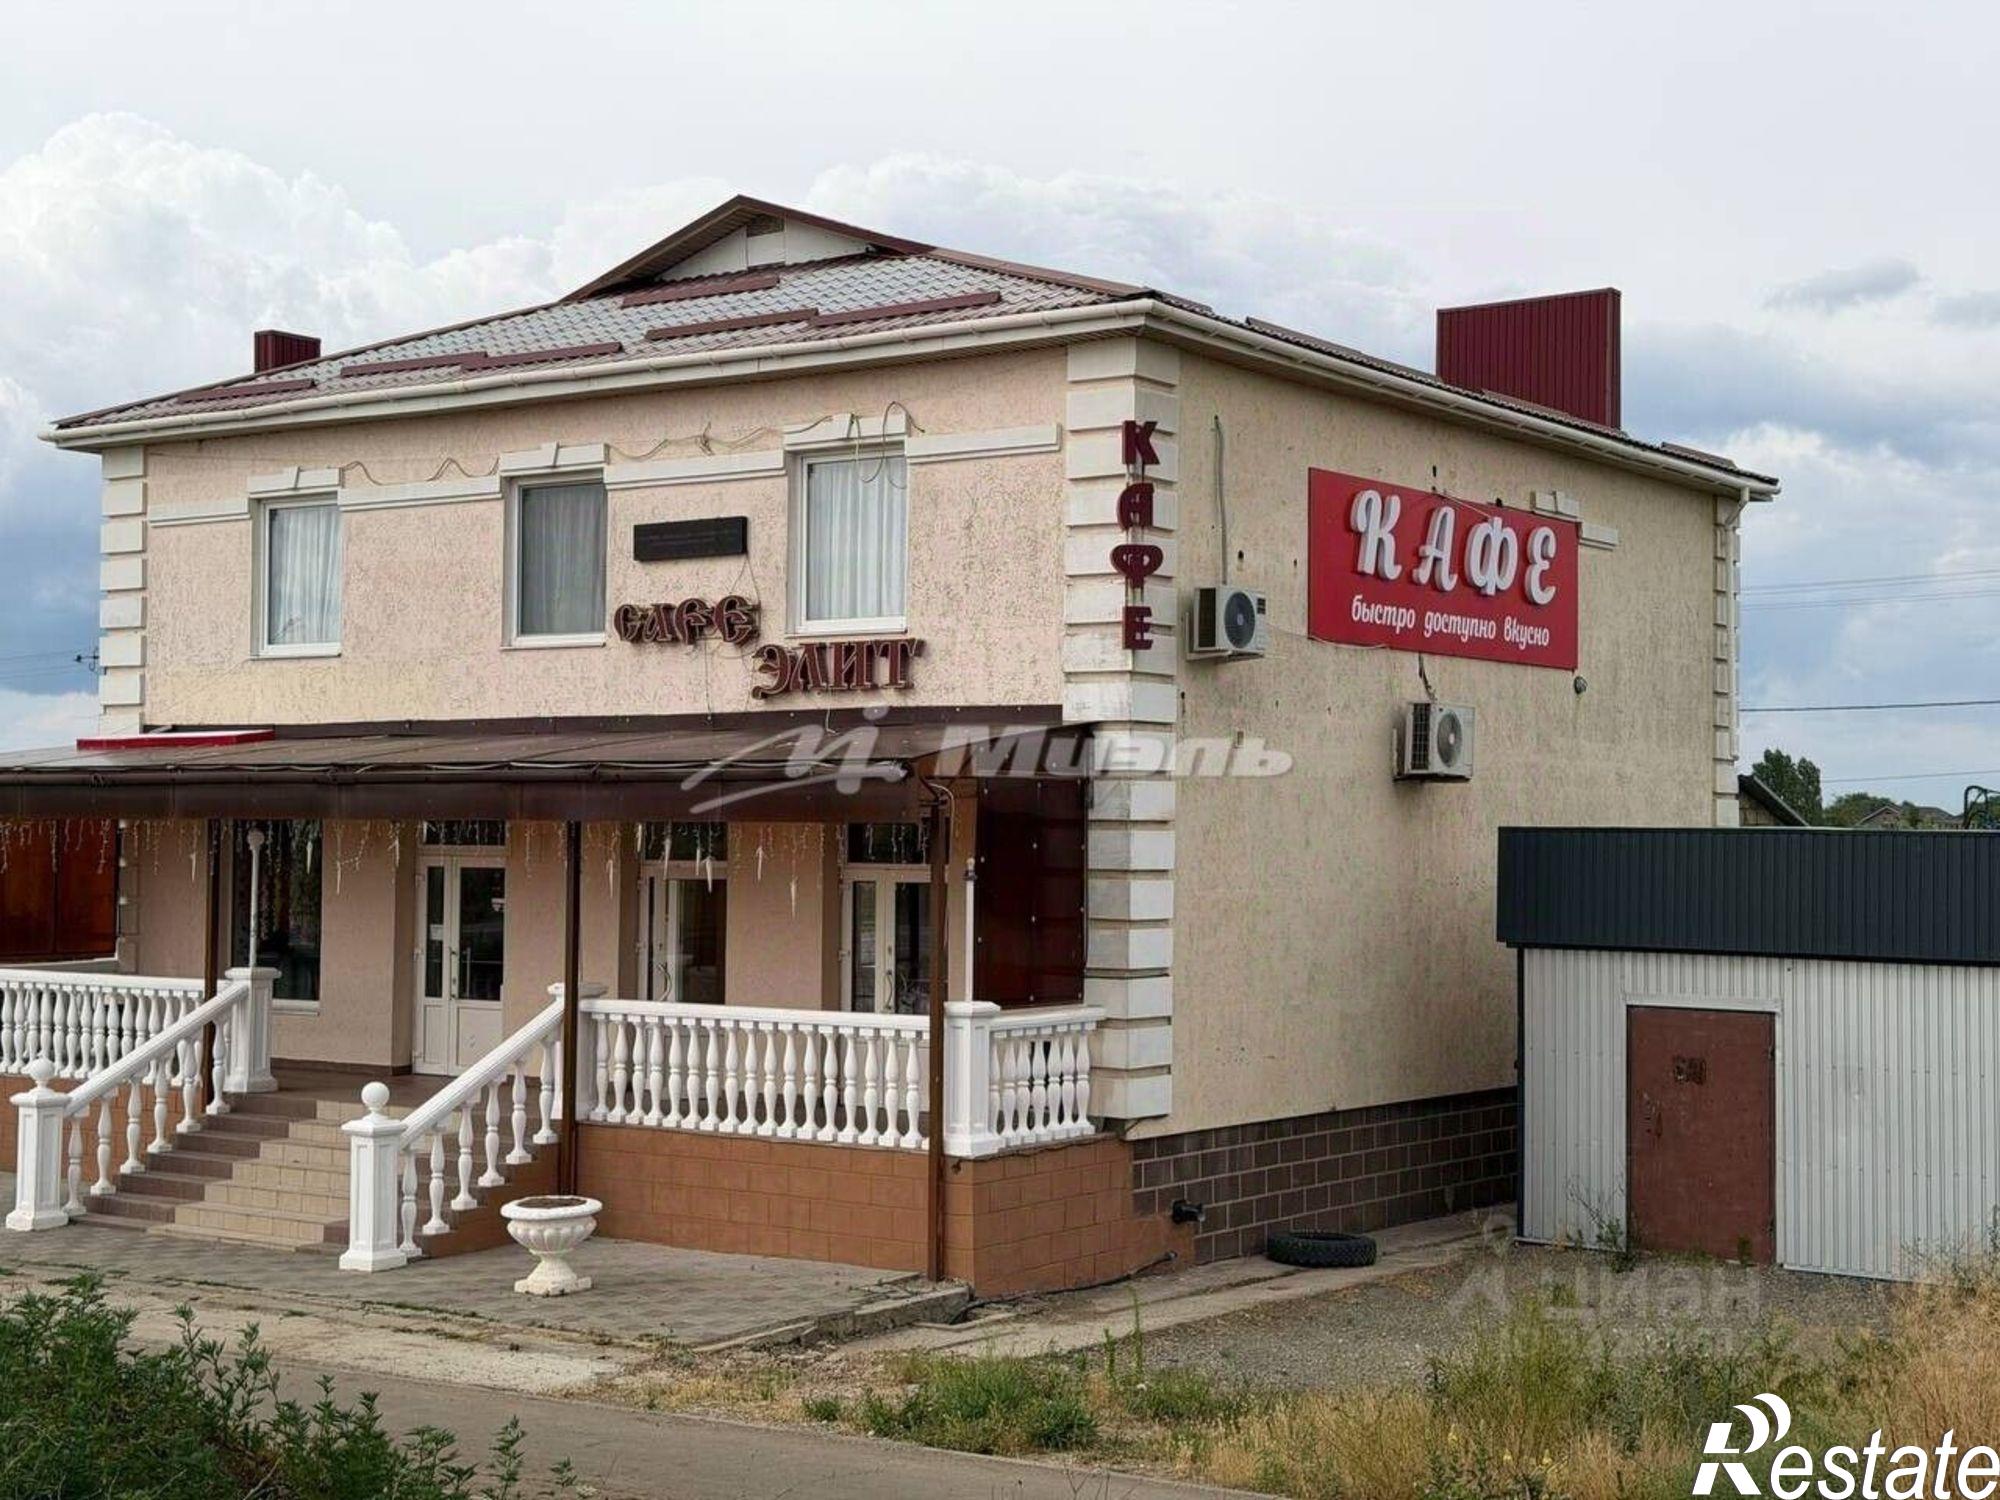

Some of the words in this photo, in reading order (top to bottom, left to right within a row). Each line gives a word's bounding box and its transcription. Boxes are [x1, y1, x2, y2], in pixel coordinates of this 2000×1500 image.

[1350, 489, 1557, 605] КАФЕ
[1351, 594, 1416, 634] быстро
[1424, 610, 1497, 641] доступно
[1503, 615, 1550, 651] вкусно
[752, 638, 925, 700] ЭЛИТ
